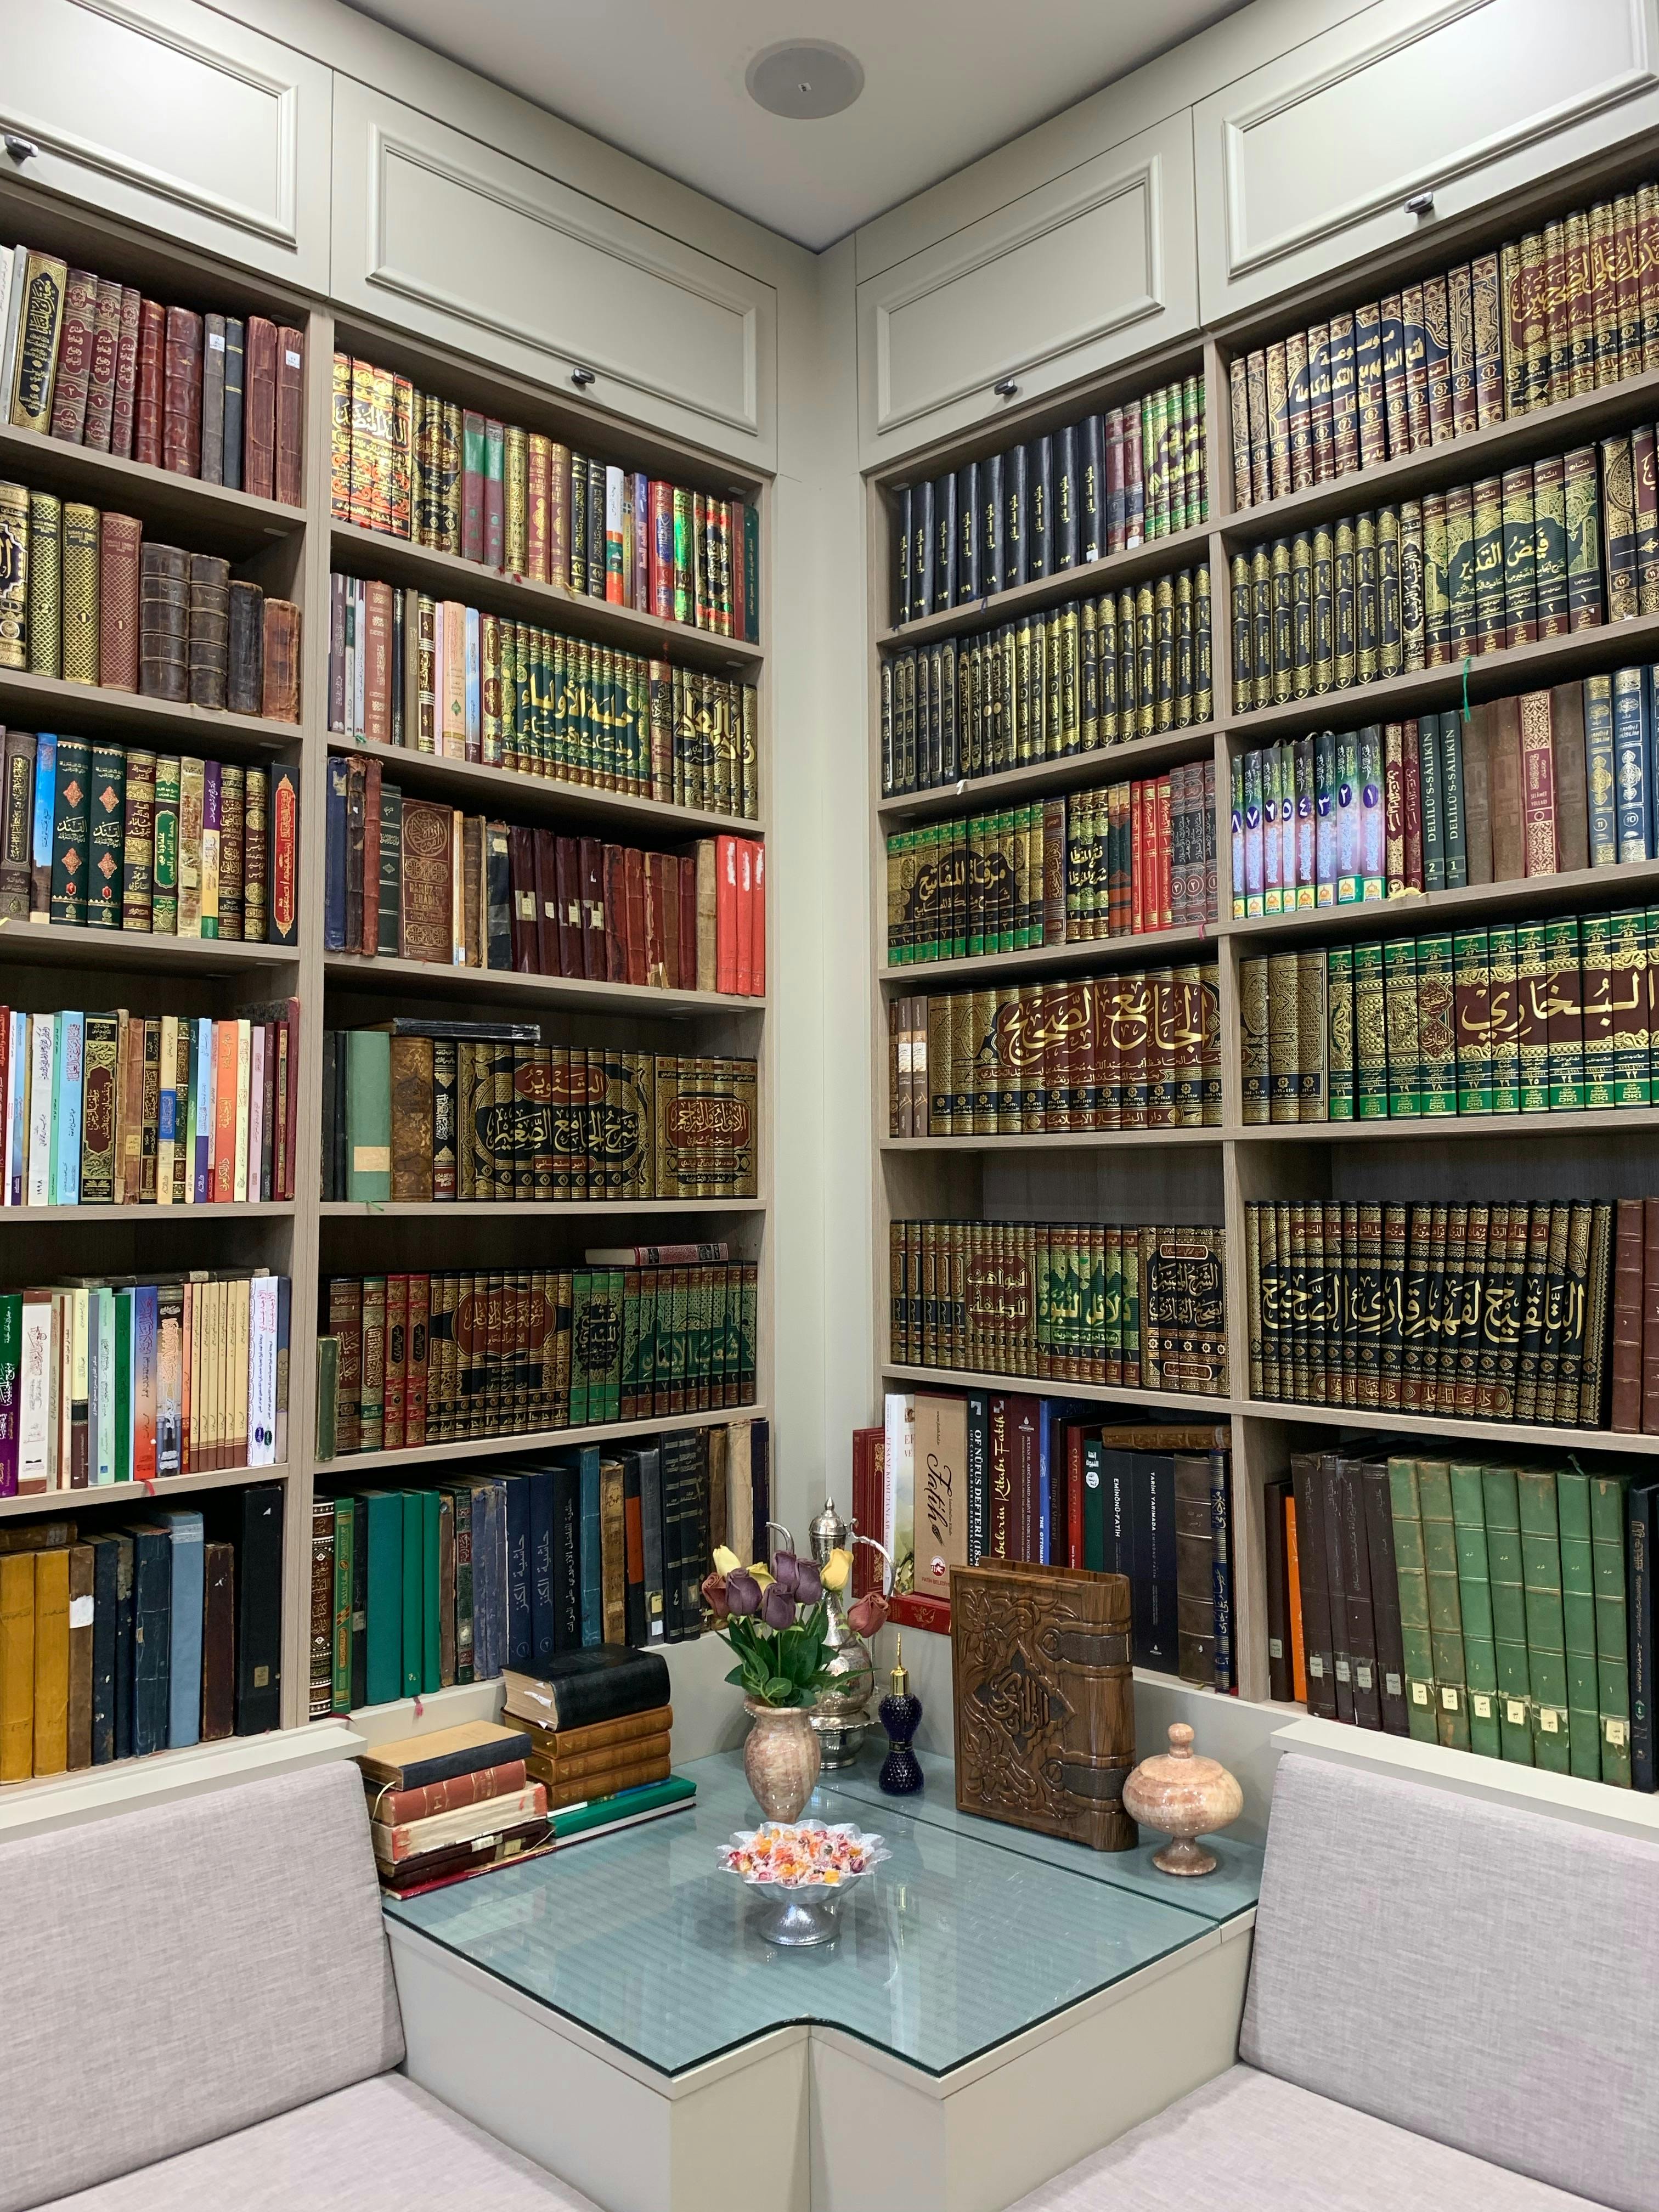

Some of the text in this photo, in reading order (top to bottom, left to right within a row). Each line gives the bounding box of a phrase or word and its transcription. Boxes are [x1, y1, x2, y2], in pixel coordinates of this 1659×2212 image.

[1319, 329, 1395, 366] موسوعة
[1406, 336, 1425, 370] فتح
[1369, 347, 1403, 381] الملهم
[1486, 369, 1492, 377] 1
[1437, 385, 1444, 394] 3
[1459, 377, 1467, 386] 2
[1393, 402, 1401, 410] 5
[1414, 394, 1421, 403] 4
[1368, 410, 1374, 420] 6
[1319, 428, 1325, 438] 8
[1342, 421, 1348, 430] 7
[1274, 442, 1285, 453] 10
[1297, 436, 1304, 444] 9
[1237, 457, 1247, 467] 12
[1255, 451, 1265, 461] 11
[1459, 526, 1550, 580] فيض القدير
[41, 602, 49, 614] 2
[521, 673, 634, 730] حلية الأولياء
[522, 716, 580, 746] الأصفياء
[674, 686, 755, 765] زاد المعاد
[1340, 787, 1347, 804] ٢
[1367, 788, 1374, 801] ١
[221, 799, 243, 814] حسن
[1282, 800, 1291, 819] ٥
[1299, 797, 1308, 817] ٤
[1318, 795, 1330, 815] ٣
[57, 815, 88, 834] القند
[1232, 814, 1241, 834] ٨
[1246, 810, 1258, 827] ٧
[1626, 816, 1636, 824] 10
[93, 821, 123, 839] القند
[223, 846, 240, 860] بلوغ
[1428, 862, 1436, 872] 2
[1451, 860, 1457, 871] 1
[919, 856, 1006, 901] مرقاة المفاتيح
[978, 887, 1010, 910] شرح
[1461, 969, 1654, 1040] البخاري
[1003, 981, 1210, 1066] الجامع الصحيح
[1421, 1029, 1448, 1048] البخاري
[523, 1069, 604, 1098] التنوير
[1499, 1079, 1510, 1087] ٢٦
[1528, 1077, 1539, 1086] ٢٥
[1560, 1075, 1573, 1084] ٢٤
[1626, 1070, 1638, 1079] ٢٢
[1335, 1088, 1345, 1097] ٣١
[1367, 1087, 1377, 1095] ٣٠
[1399, 1084, 1409, 1093] ٢٩
[1431, 1083, 1443, 1092] ٢٨
[1468, 1080, 1480, 1088] ٢٧
[87, 1089, 100, 1131] مواهب الرحمن
[1047, 1111, 1162, 1127] دار البشائر الإسلامية
[487, 1107, 639, 1153] شرح الجامع الصغير
[1188, 1262, 1218, 1296] الشرح
[524, 1301, 544, 1327] شرح
[1039, 1283, 1131, 1327] دلائل النبوة
[1149, 1296, 1193, 1325] البخاري
[1262, 1271, 1584, 1344] التلقيح لفهم قارئ الصحيح
[580, 1306, 617, 1330] فتح
[642, 1333, 738, 1377] شعب الإيمان
[975, 1429, 982, 1447] OF
[994, 1414, 1010, 1456] Fatih
[924, 1453, 952, 1532] Fatih
[974, 1488, 983, 1538] DEFTERİ
